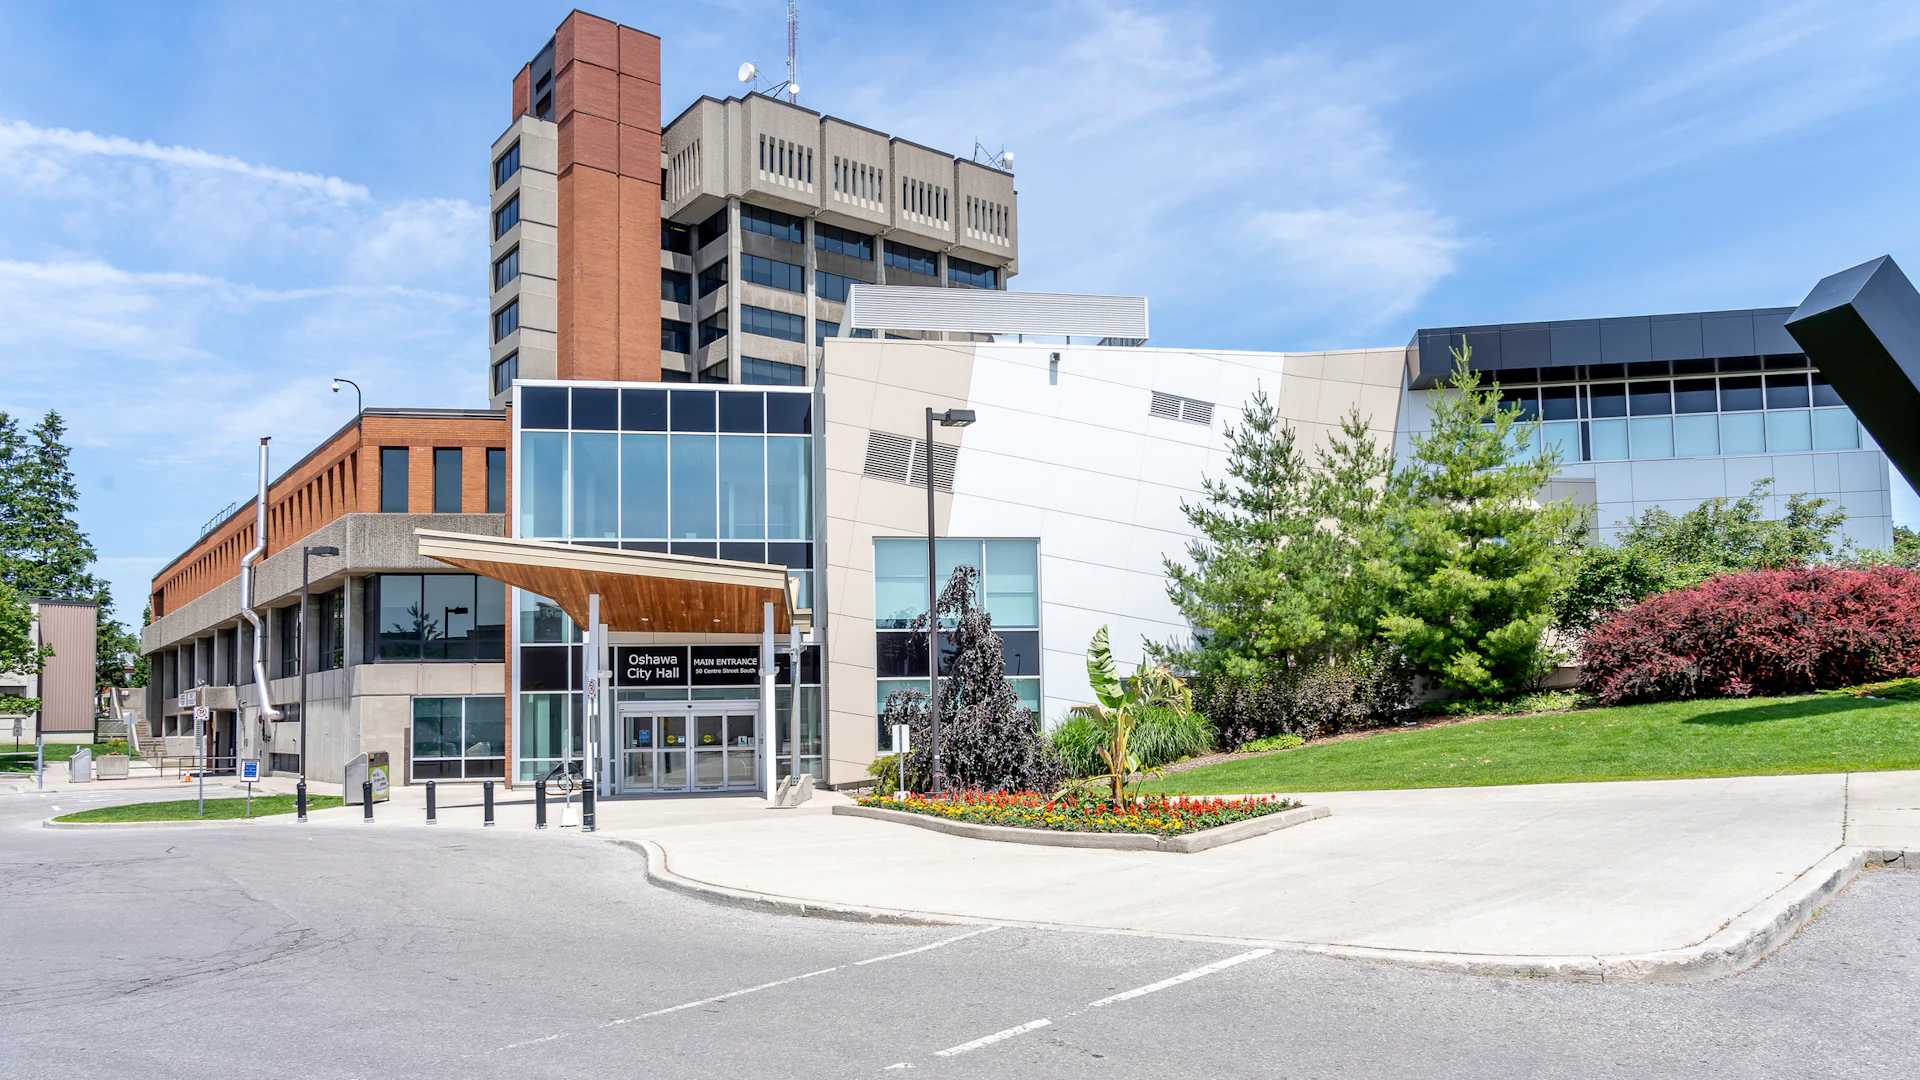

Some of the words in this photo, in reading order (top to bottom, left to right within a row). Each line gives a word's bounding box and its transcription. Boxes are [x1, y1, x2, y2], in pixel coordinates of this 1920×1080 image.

[628, 653, 678, 665] Oshawa
[693, 658, 715, 666] MAIN
[716, 657, 758, 666] ENTRANCE
[626, 667, 652, 681] City
[656, 667, 680, 679] Hall
